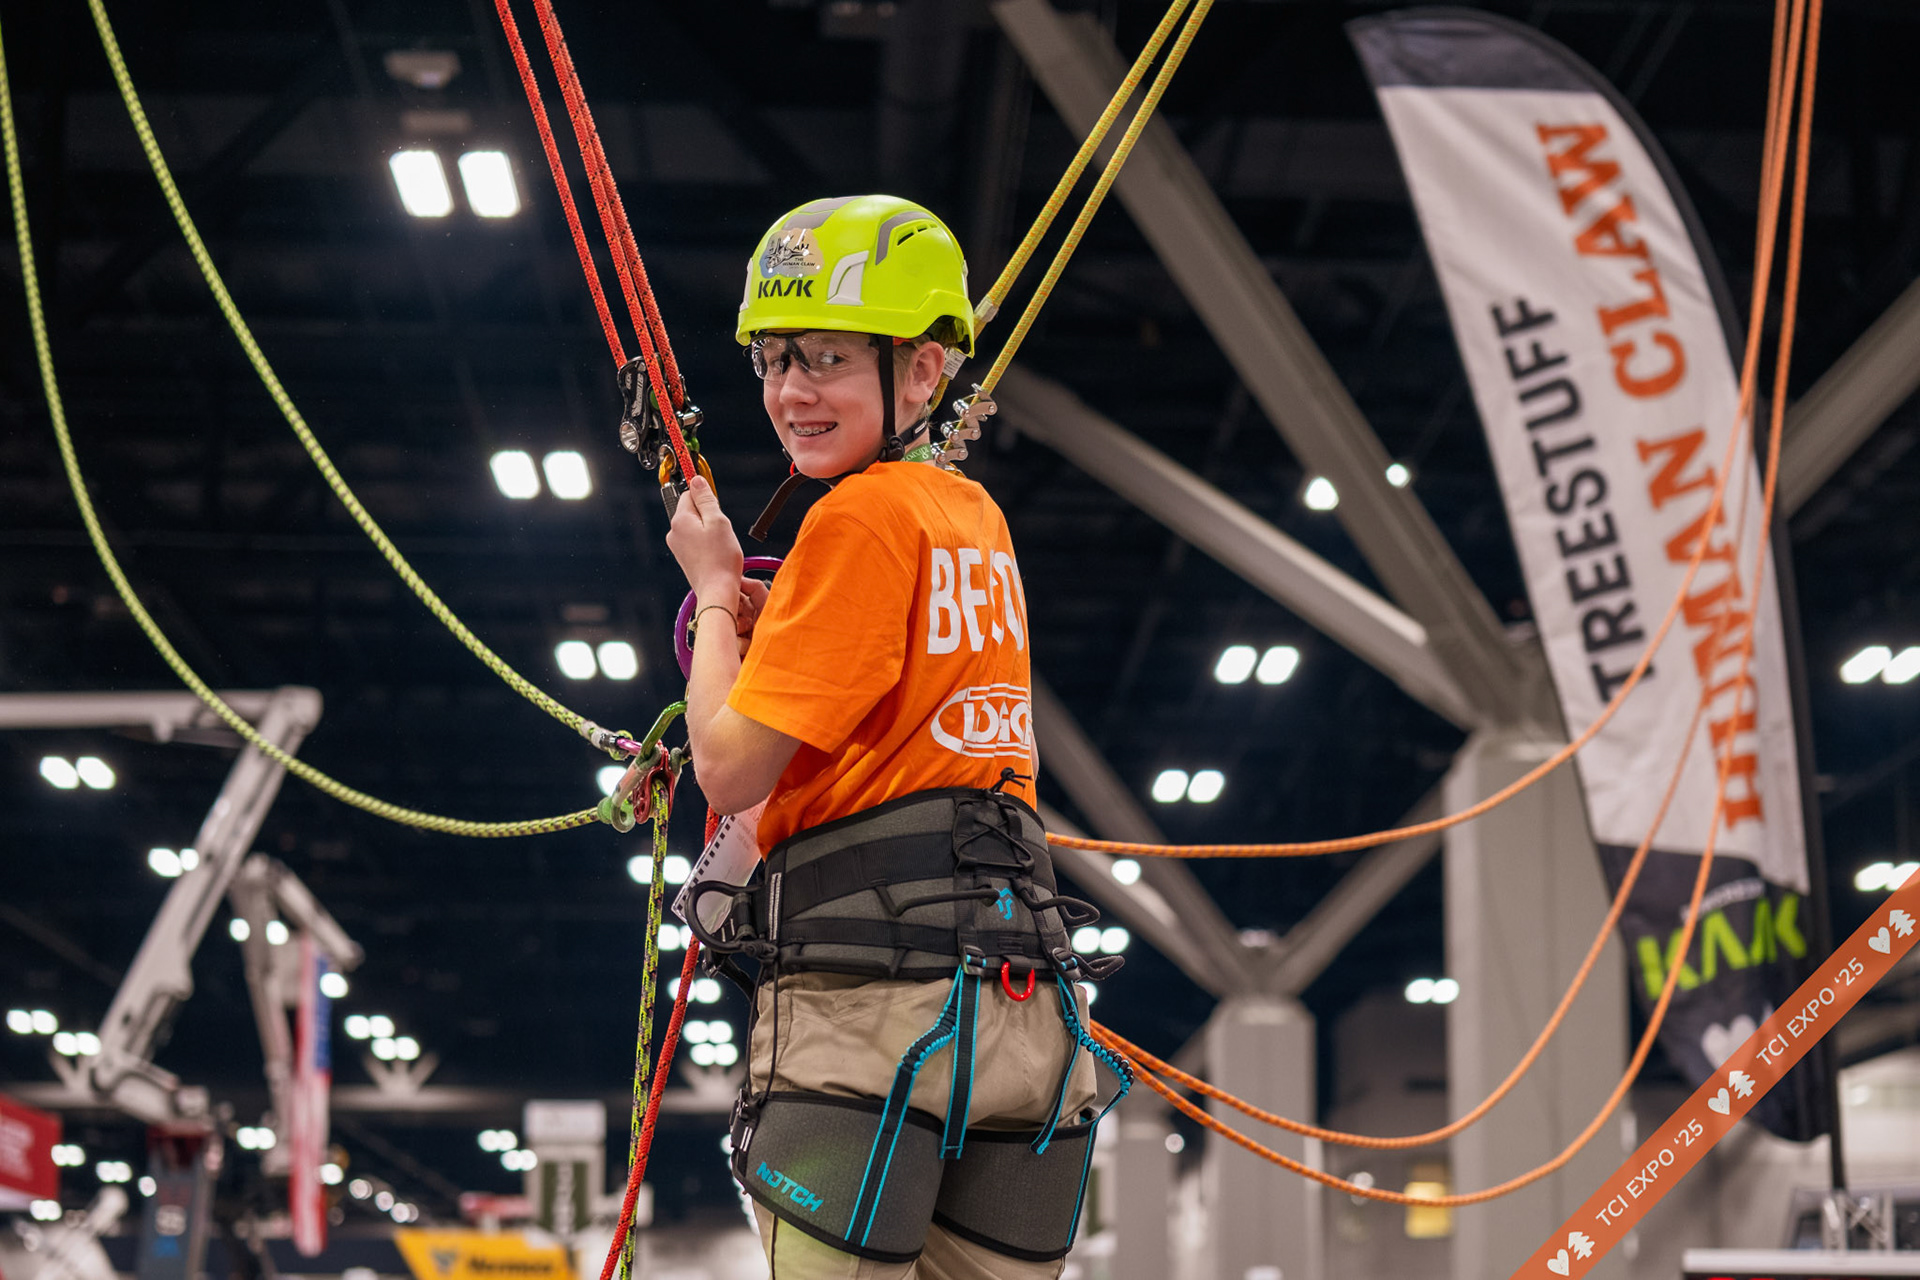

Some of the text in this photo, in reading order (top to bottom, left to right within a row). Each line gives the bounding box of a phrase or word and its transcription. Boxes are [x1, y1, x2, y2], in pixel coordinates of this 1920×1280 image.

[757, 279, 814, 299] KASK
[1535, 120, 1687, 400] CLAW
[1490, 296, 1656, 702] TREESTUFF
[756, 1161, 824, 1213] NOTCH
